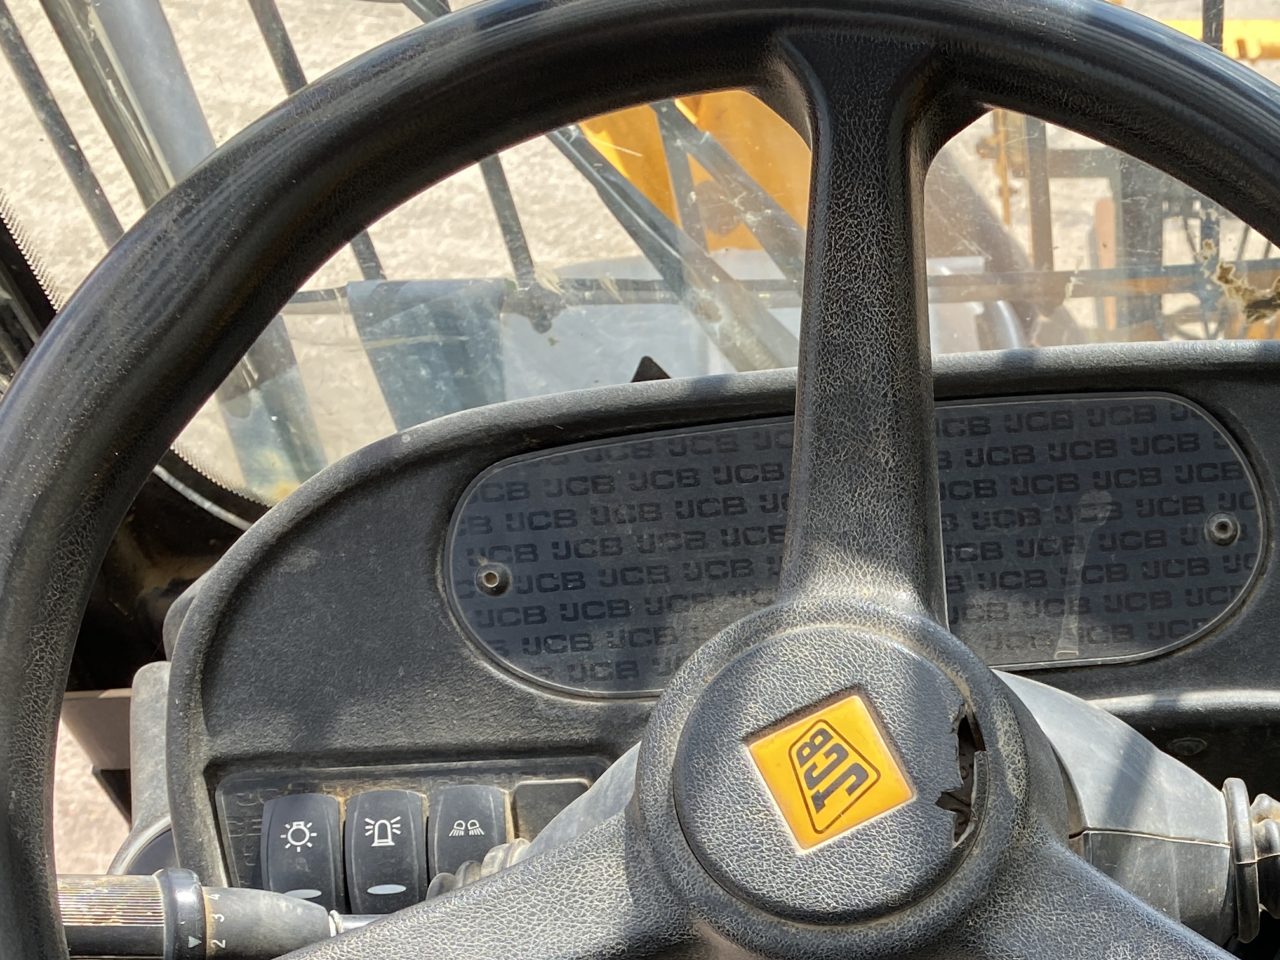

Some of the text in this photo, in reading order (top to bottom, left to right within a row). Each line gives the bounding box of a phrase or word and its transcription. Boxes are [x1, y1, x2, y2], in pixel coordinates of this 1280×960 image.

[936, 416, 991, 437] CB
[1004, 410, 1073, 433] JCB
[1087, 405, 1157, 427] JCB
[753, 431, 792, 450] JC
[965, 445, 1035, 467] JCB
[1048, 439, 1118, 462] JCB
[1130, 433, 1200, 456] JCB
[468, 463, 784, 504] CB JCB JCB JCB
[1010, 473, 1079, 495] JCB
[1093, 467, 1161, 490] JCB
[1174, 461, 1244, 484] JCB
[506, 509, 577, 532] JCB
[676, 496, 747, 519] JCB
[971, 508, 1041, 530] JCB
[1136, 496, 1205, 518] JCB
[1218, 491, 1256, 512] JC
[552, 537, 622, 560] JCB
[1098, 529, 1167, 552] JCB
[515, 571, 585, 594] JCB
[599, 565, 670, 587] JCB
[682, 558, 753, 581] JCB
[978, 569, 1047, 590] JCB
[1142, 557, 1209, 580] JCB
[1222, 553, 1257, 574] JC
[475, 605, 547, 628] JCB
[560, 599, 631, 622] JCB
[1104, 590, 1172, 613] JCB
[522, 633, 593, 655] JCB
[796, 728, 869, 814] JCB
[212, 914, 225, 922] 3
[211, 940, 226, 948] 2
